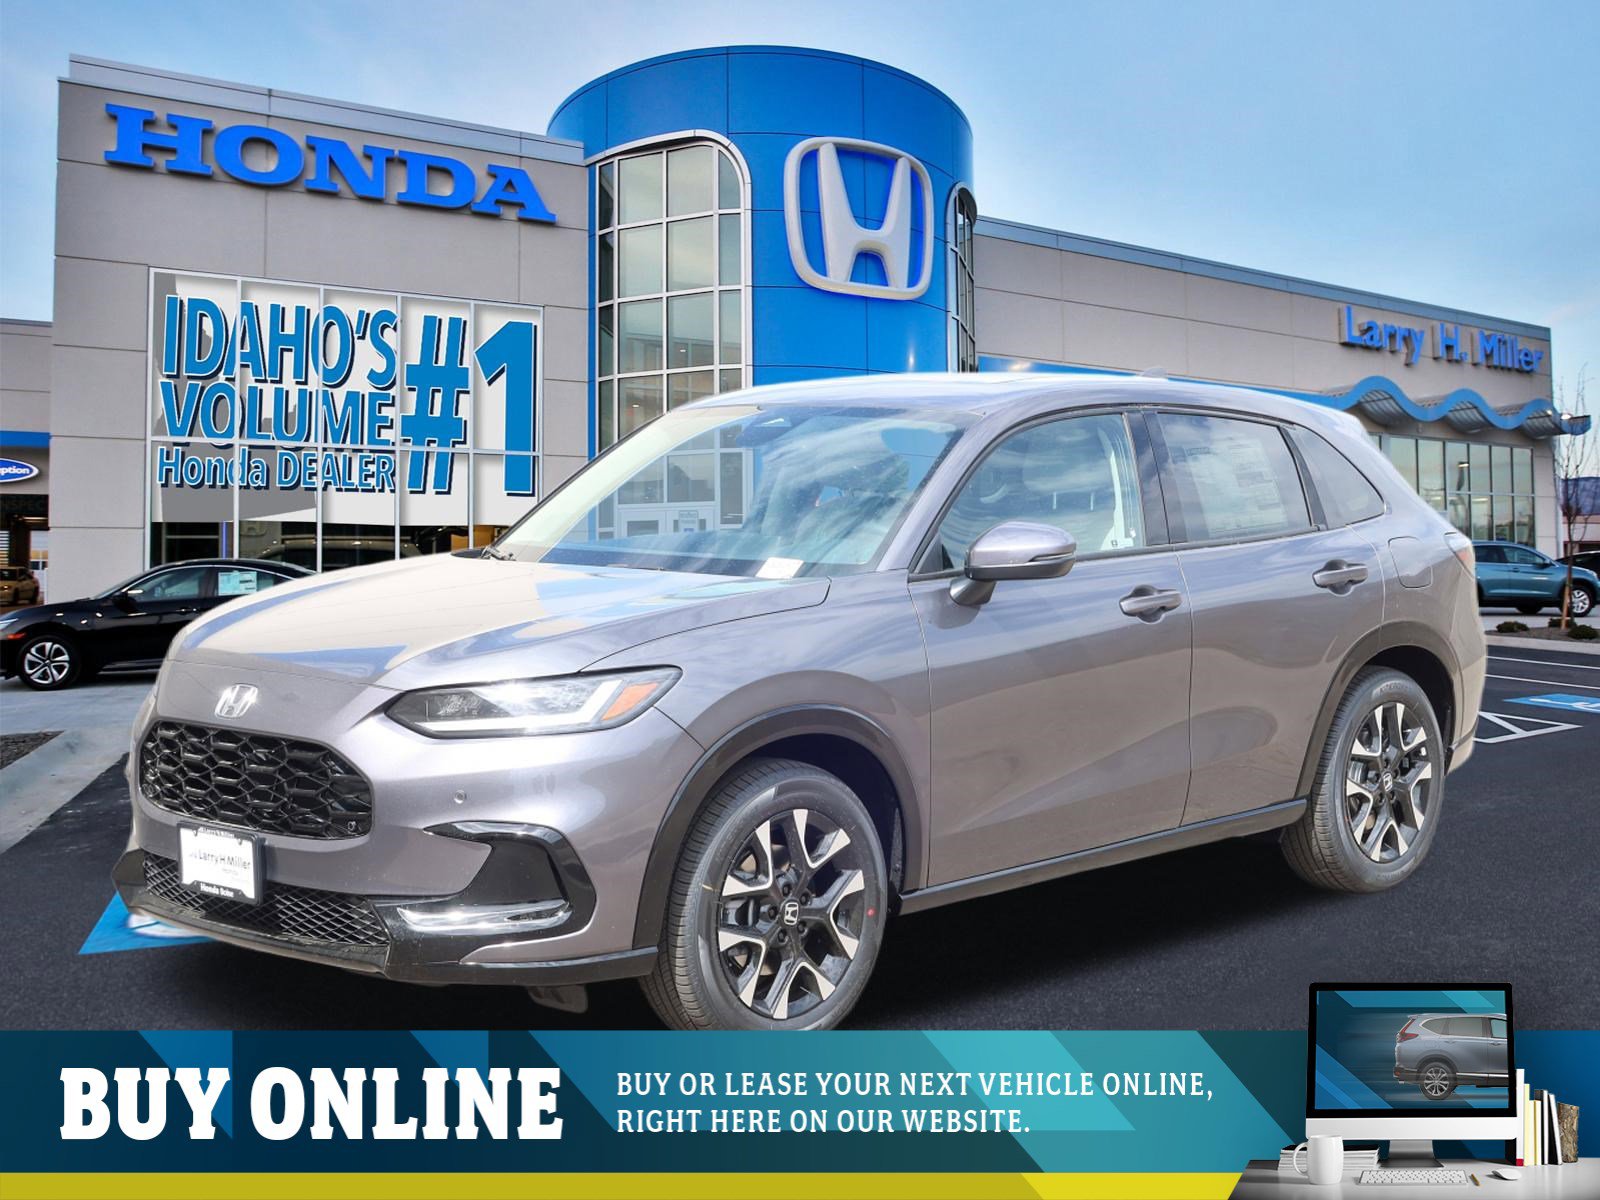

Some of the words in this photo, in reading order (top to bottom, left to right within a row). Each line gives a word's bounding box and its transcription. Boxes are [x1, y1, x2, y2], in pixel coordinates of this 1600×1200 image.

[104, 104, 557, 223] HONDA
[161, 295, 398, 388] IDAHO'S
[1339, 305, 1424, 366] Larry
[1434, 322, 1468, 361] H.
[1473, 330, 1545, 373] Miller
[159, 380, 398, 448] VOLUME
[400, 315, 537, 496] #1
[157, 446, 268, 489] Honda
[276, 450, 397, 493] DEALER
